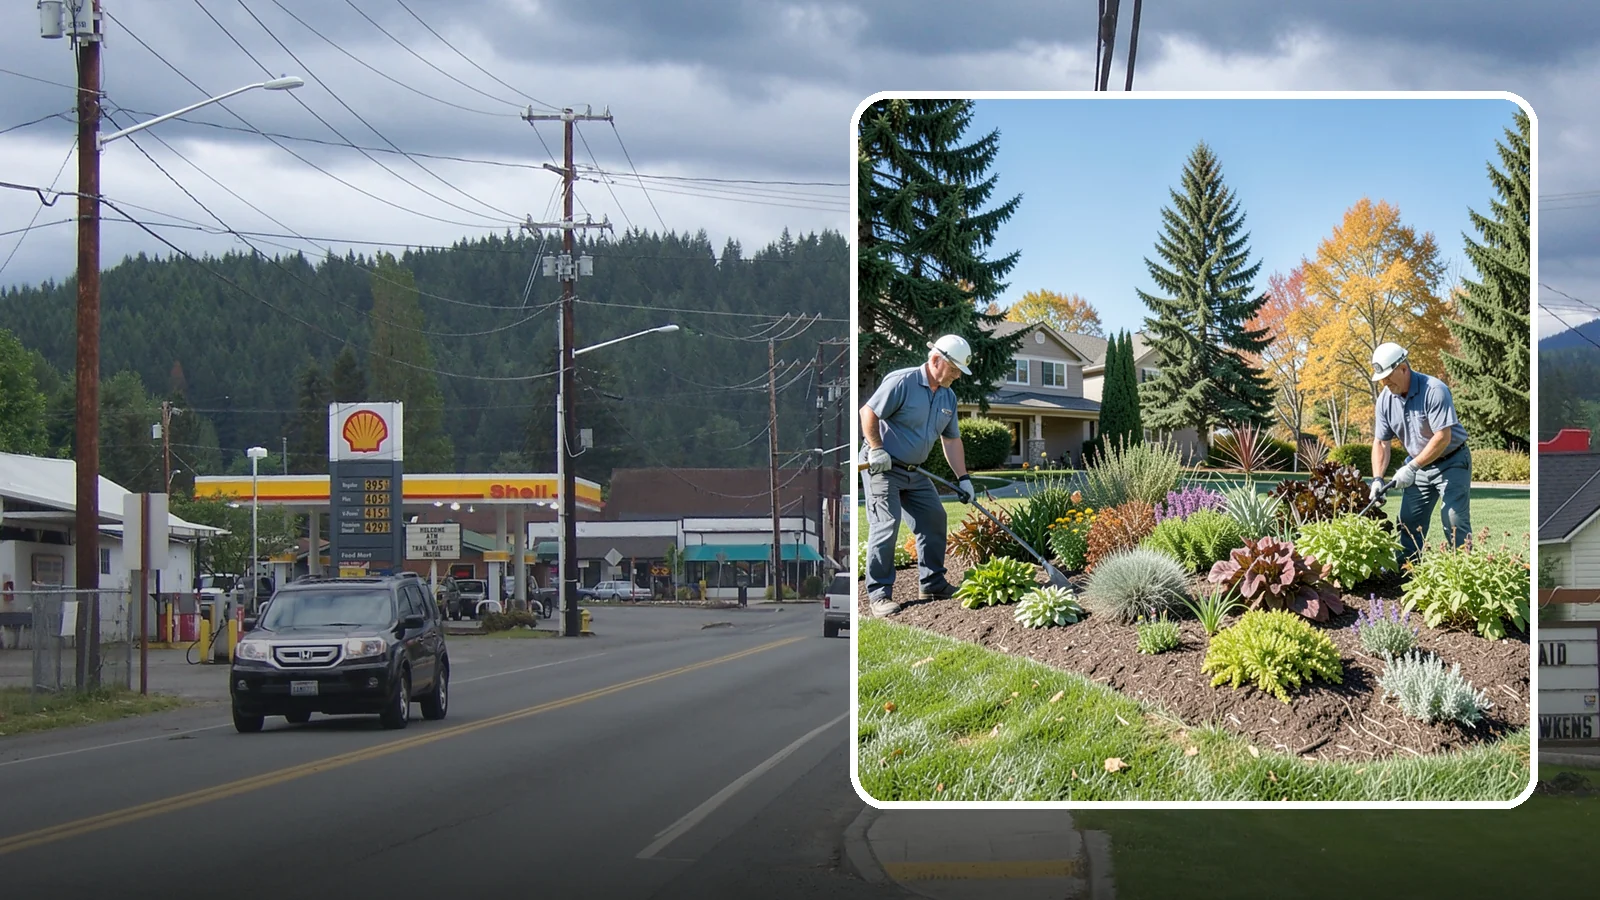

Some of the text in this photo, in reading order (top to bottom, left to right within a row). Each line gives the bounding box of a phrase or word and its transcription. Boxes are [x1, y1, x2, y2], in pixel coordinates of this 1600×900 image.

[365, 480, 383, 490] 395
[490, 485, 547, 499] Shell
[366, 494, 383, 504] 405
[366, 508, 383, 518] 415
[366, 523, 383, 532] 429
